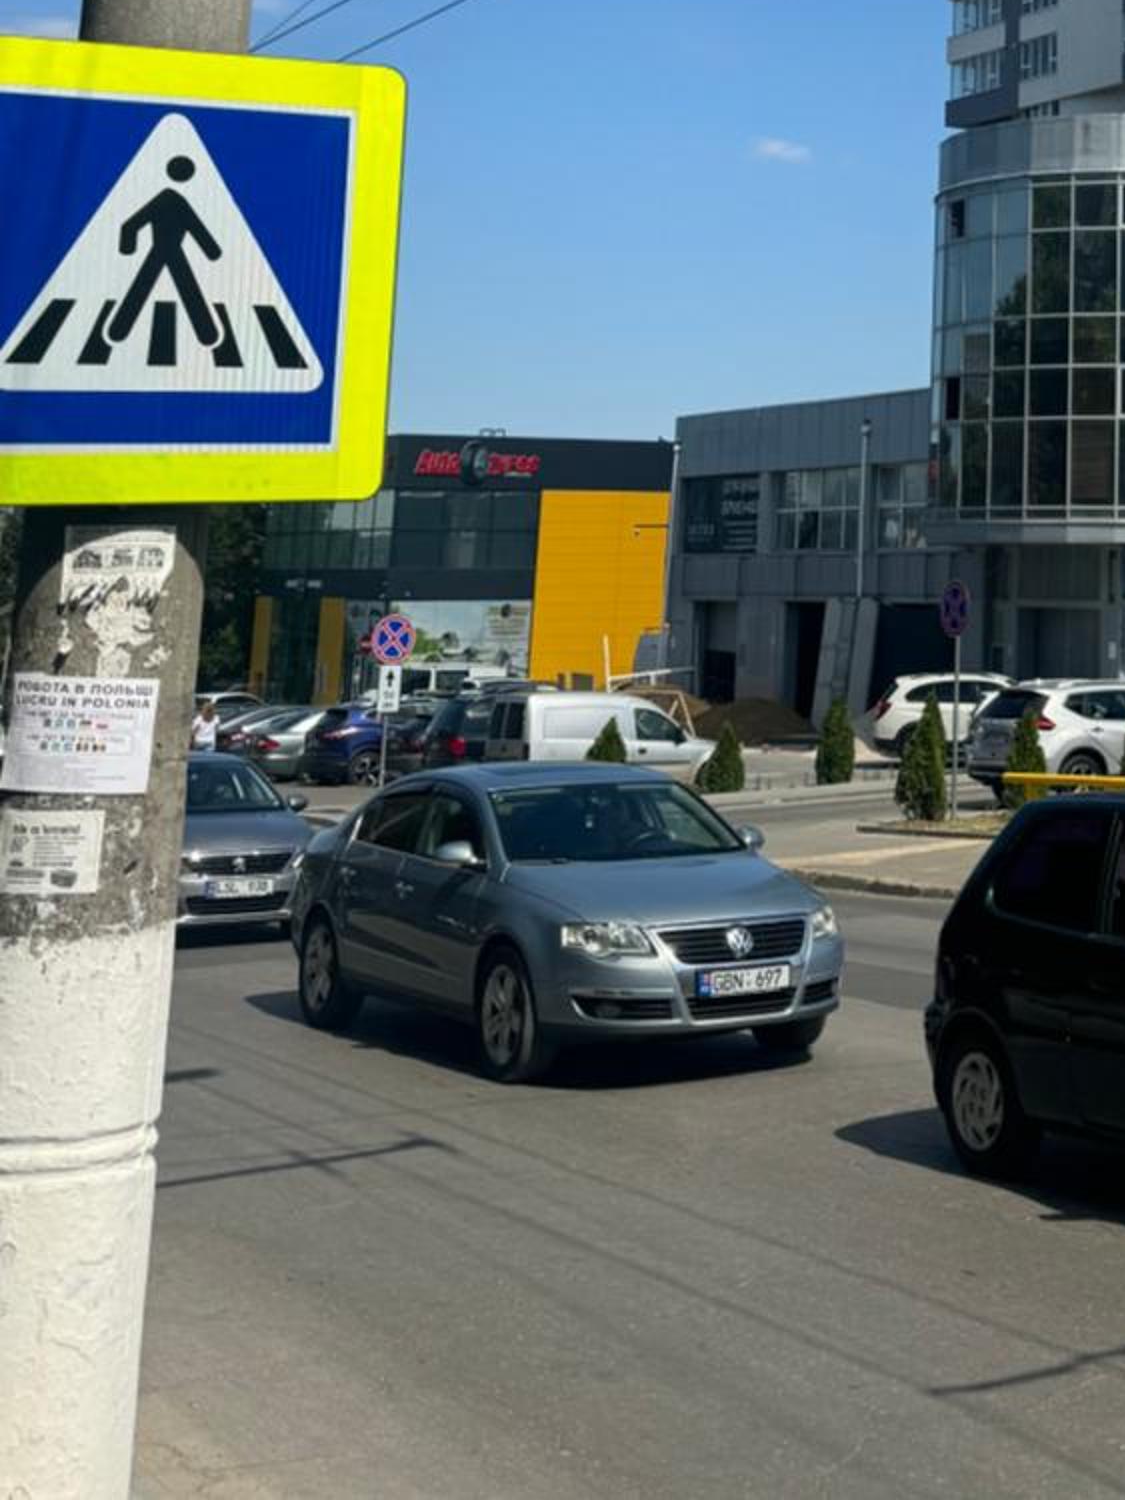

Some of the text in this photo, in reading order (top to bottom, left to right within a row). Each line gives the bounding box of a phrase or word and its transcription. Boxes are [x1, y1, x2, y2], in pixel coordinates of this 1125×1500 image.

[15, 695, 150, 709] LUCRU IN POLONIA
